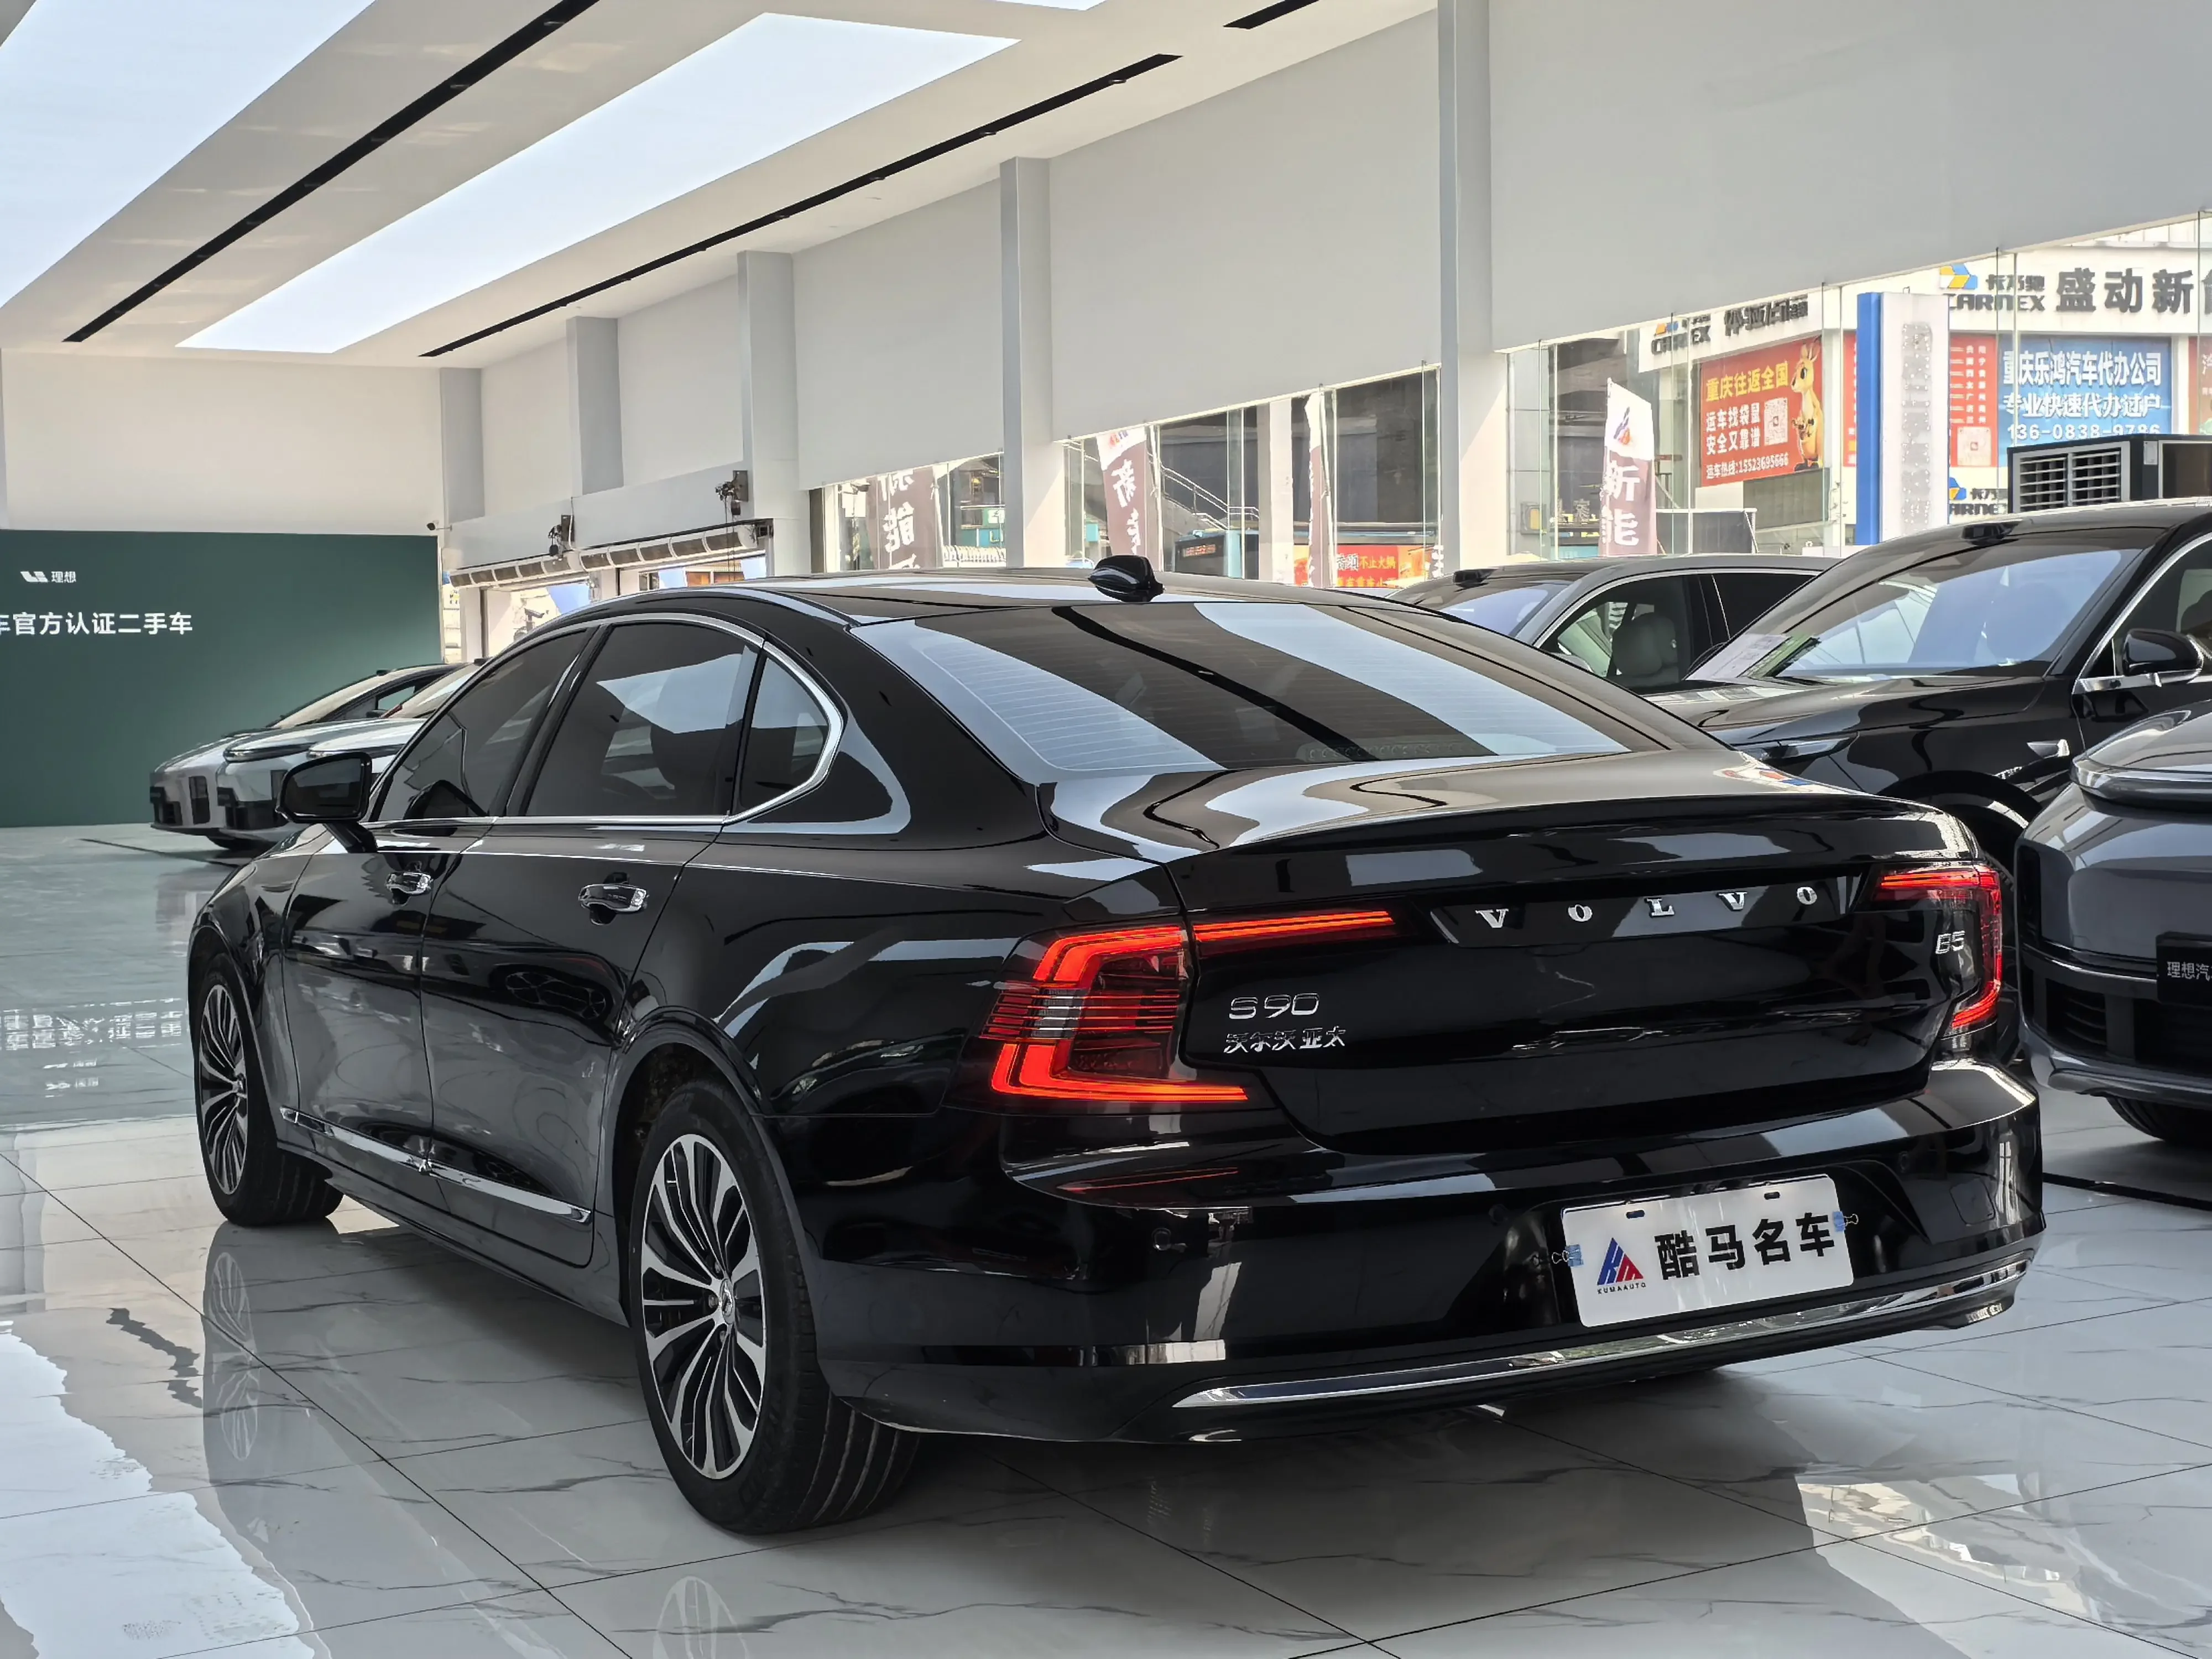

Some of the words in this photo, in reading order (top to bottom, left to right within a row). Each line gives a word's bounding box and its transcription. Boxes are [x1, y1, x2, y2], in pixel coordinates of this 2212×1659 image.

[2056, 267, 2212, 315] 盛动新
[1706, 361, 1788, 402] 重庆往返全国
[2003, 350, 2161, 387] 重庆乐鸿汽车代办公司
[2003, 392, 2161, 418] 专业快速代办过户
[51, 571, 76, 583] 理想
[1475, 886, 1818, 928] VOLVO
[1935, 930, 1965, 954] B5
[2167, 961, 2212, 982] 理想汽
[1229, 993, 1319, 1019] S90
[1224, 1025, 1346, 1053] 沃尔沃亚太
[1654, 1212, 1835, 1281] 酷马名车
[1598, 1282, 1646, 1295] KUMAAUTO
